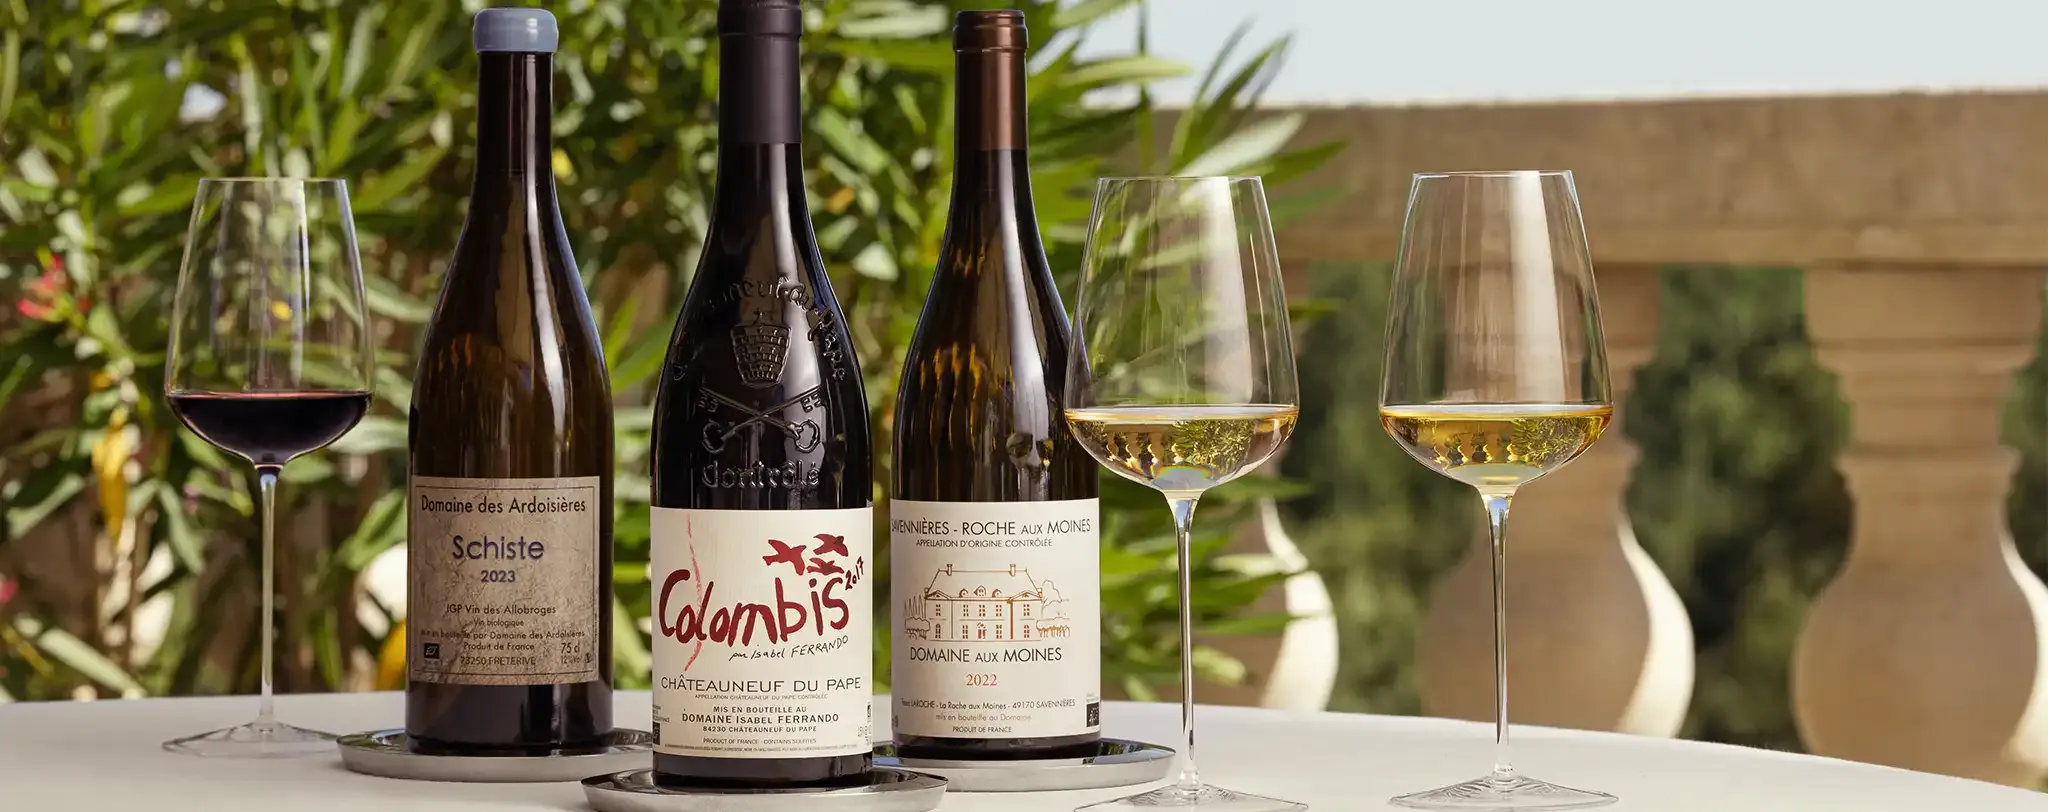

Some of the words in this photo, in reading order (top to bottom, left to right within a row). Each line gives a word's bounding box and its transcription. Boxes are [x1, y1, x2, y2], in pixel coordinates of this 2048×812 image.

[421, 495, 473, 513] Domaine
[478, 497, 503, 513] des
[508, 496, 586, 513] Ardoisières
[892, 517, 949, 535] SAVENNIÈRES
[962, 521, 1016, 535] ROCHE
[1020, 524, 1043, 535] AUX
[1047, 518, 1091, 534] MOINES
[452, 535, 544, 560] Schiste
[916, 539, 958, 548] APPELLATION
[960, 539, 1003, 548] D'ORIGINE
[1004, 538, 1052, 547] CONTRÔLÉE
[480, 570, 516, 583] 2023
[845, 556, 864, 590] 2017
[446, 604, 462, 613] IGP
[465, 605, 480, 614] Vin
[483, 605, 500, 614] des
[503, 605, 556, 616] Allobroges
[659, 569, 849, 647] Colombis
[487, 618, 524, 628] biologique
[490, 631, 527, 639] Domaine
[529, 631, 543, 639] des
[463, 642, 491, 650] Produit
[494, 642, 504, 650] de
[507, 642, 535, 650] France
[561, 642, 572, 654] 75
[791, 635, 849, 658] FERRANDO
[910, 647, 970, 662] DOMAINE
[975, 652, 998, 663] AUX
[1003, 647, 1062, 662] MOINES
[661, 674, 784, 693] CHÂTEAUNEUF
[794, 680, 818, 692] DU
[826, 677, 861, 691] PAPE
[966, 674, 997, 686] 2022
[948, 701, 967, 709] Roche
[1036, 699, 1076, 708] SAVENNIÈRES
[682, 713, 732, 724] DOMAINE
[778, 713, 839, 724] FERRANDO
[728, 725, 784, 733] CHÂTEAUNEUF
